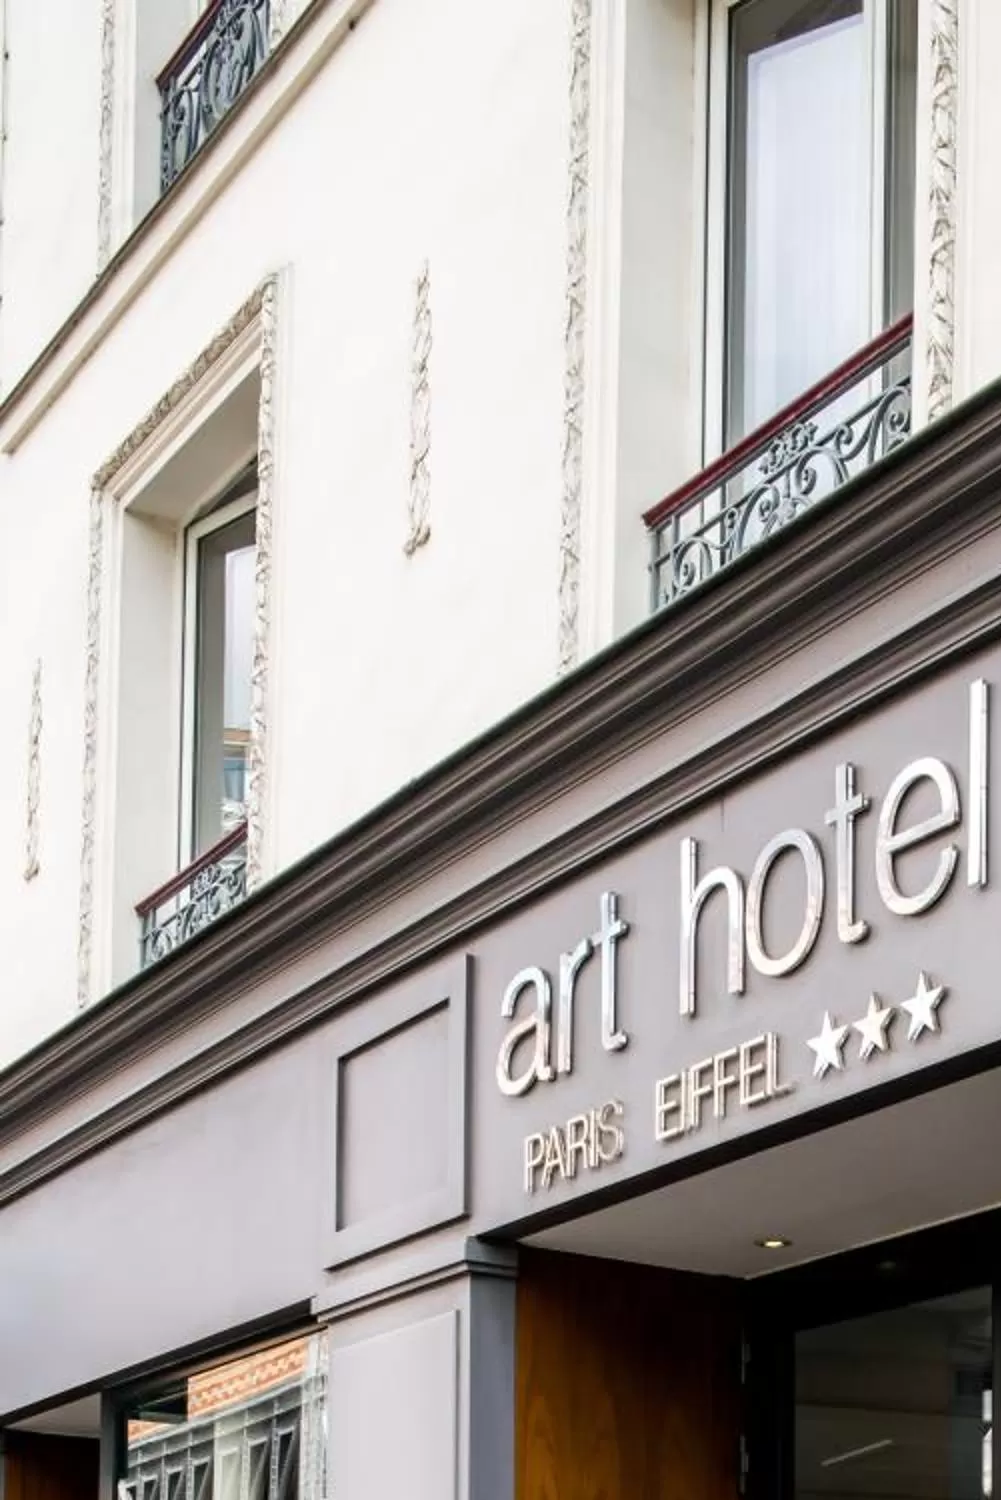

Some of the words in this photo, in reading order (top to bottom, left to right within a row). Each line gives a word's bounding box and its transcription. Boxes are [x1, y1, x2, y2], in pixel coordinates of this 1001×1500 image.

[496, 890, 629, 1096] art
[679, 677, 991, 1018] hotel
[524, 1099, 624, 1194] PARIS
[654, 1030, 798, 1142] EIFFEL
